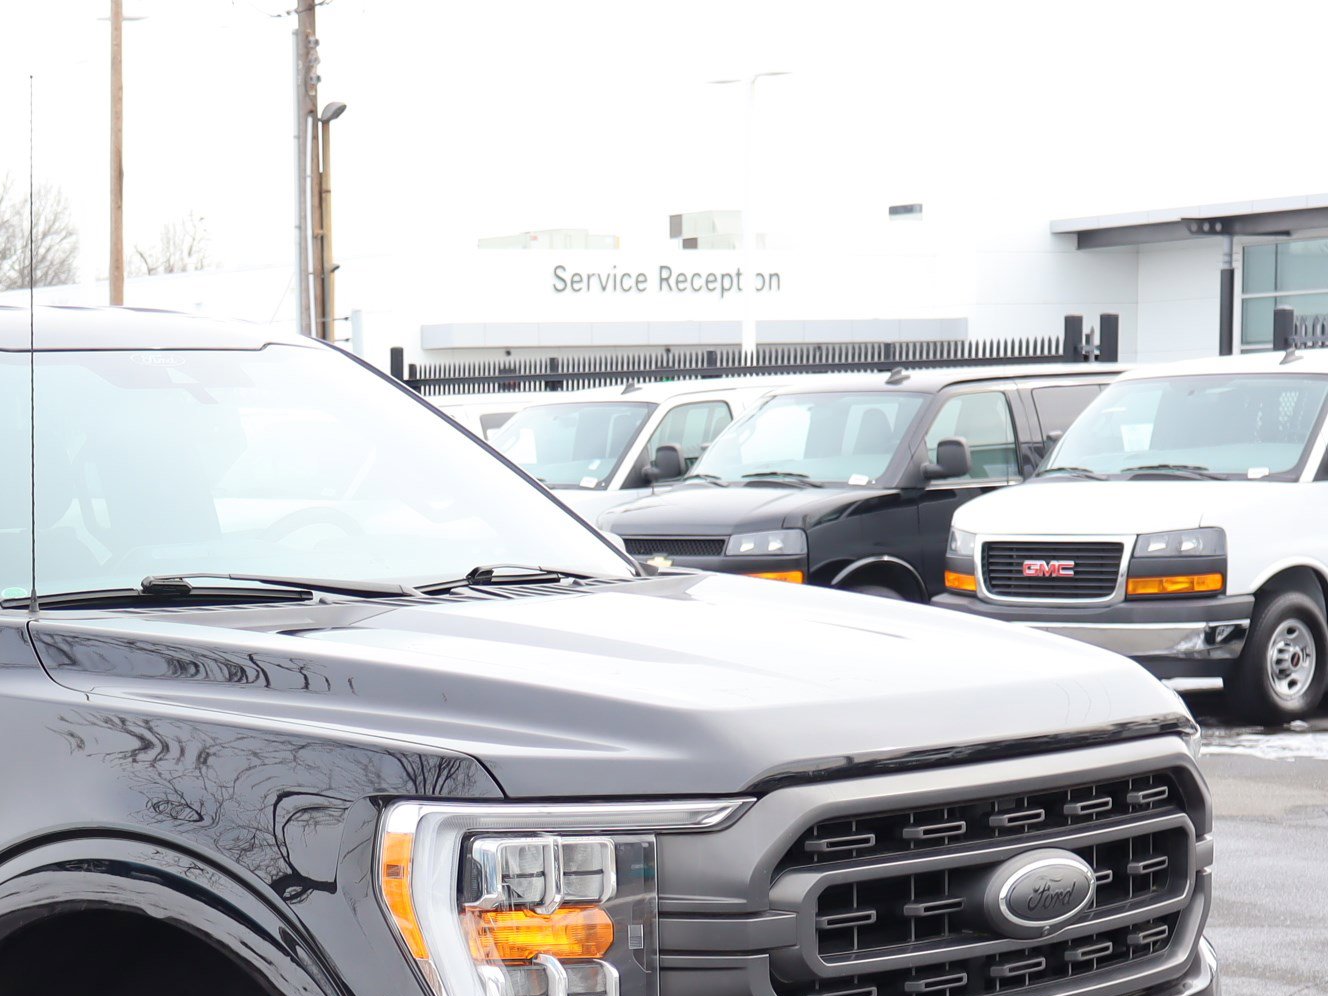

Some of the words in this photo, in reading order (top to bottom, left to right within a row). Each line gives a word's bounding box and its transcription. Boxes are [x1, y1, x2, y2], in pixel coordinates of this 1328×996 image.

[552, 265, 648, 292] Service
[659, 265, 781, 298] Recepton
[1023, 560, 1075, 577] GMC
[1028, 877, 1077, 912] Ford
